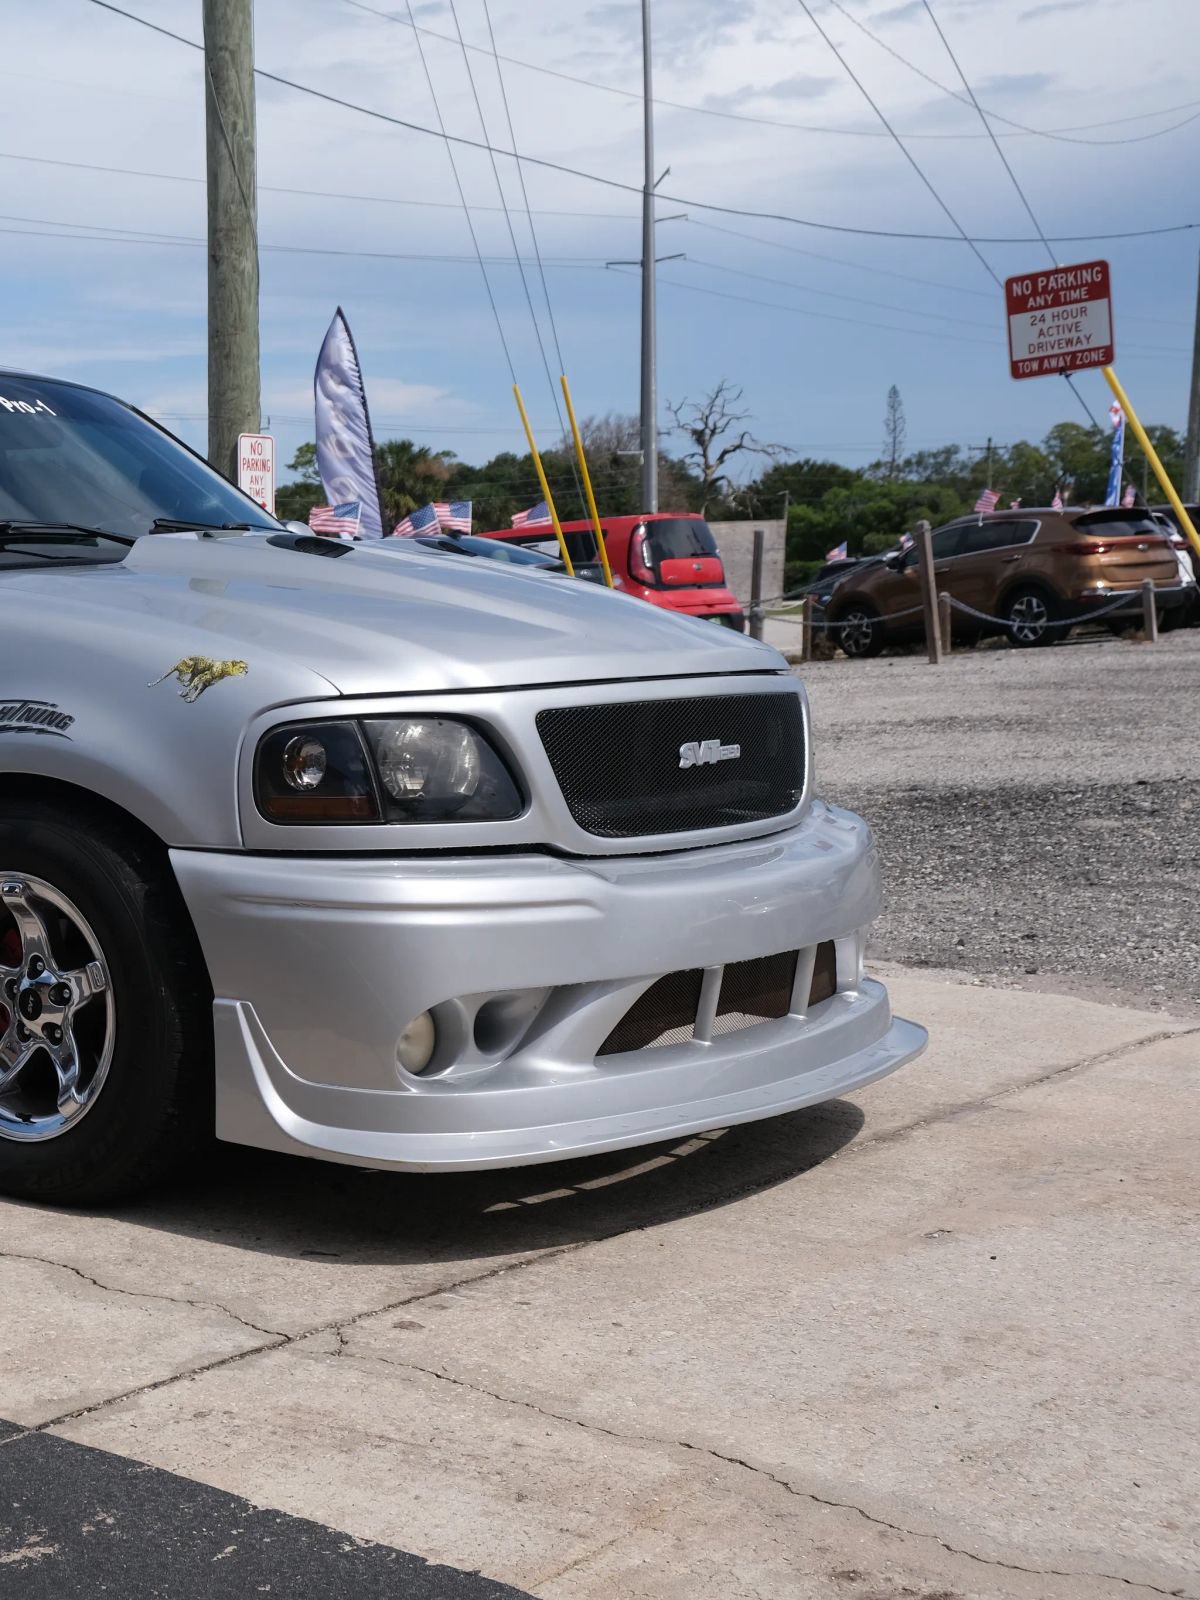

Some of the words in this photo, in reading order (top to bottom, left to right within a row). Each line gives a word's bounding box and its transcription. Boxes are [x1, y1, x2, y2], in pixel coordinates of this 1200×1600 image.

[1012, 280, 1032, 297] NO
[1038, 267, 1102, 292] PARKING
[1027, 293, 1054, 308] ANY
[1059, 287, 1089, 303] TIME
[1030, 314, 1046, 326] 24
[1052, 306, 1088, 322] HOUR
[1038, 321, 1083, 338] ACTIVE
[1028, 333, 1093, 354] DRIVEWAY
[1018, 361, 1039, 374] TOW
[1043, 355, 1072, 370] AWAY
[1076, 349, 1105, 365] ZONE
[250, 441, 263, 456] NO
[242, 457, 271, 473] PARKING
[249, 475, 264, 486] ANY
[249, 487, 265, 499] TIME
